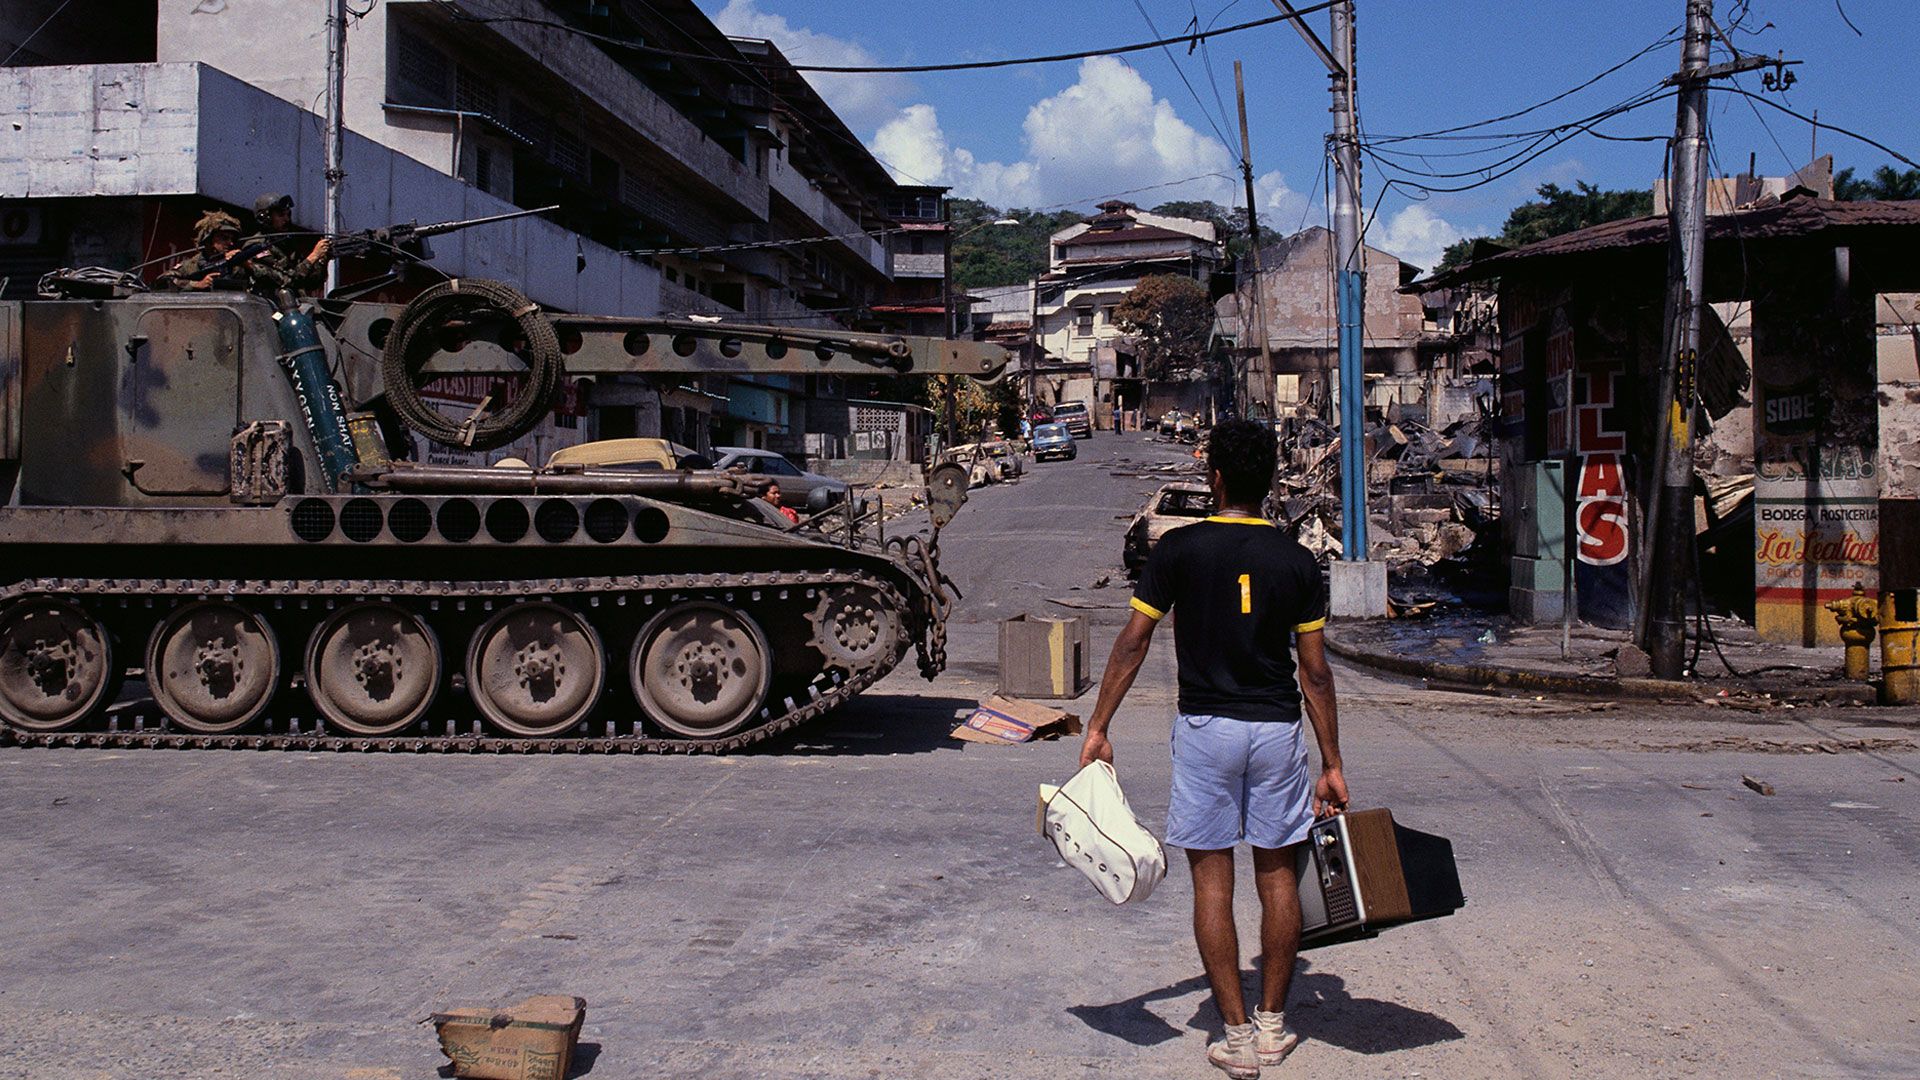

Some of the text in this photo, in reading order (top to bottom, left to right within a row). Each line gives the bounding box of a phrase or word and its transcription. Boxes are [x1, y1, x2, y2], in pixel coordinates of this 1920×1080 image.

[326, 384, 353, 448] NON SHAT
[1765, 392, 1815, 424] SOBE
[1762, 509, 1812, 521] BODEGA
[1820, 509, 1877, 521] ROSTICERIA
[1757, 529, 1878, 563] La Lealtad
[1766, 568, 1864, 579] POLLO ASADO
[1238, 573, 1252, 613] 1
